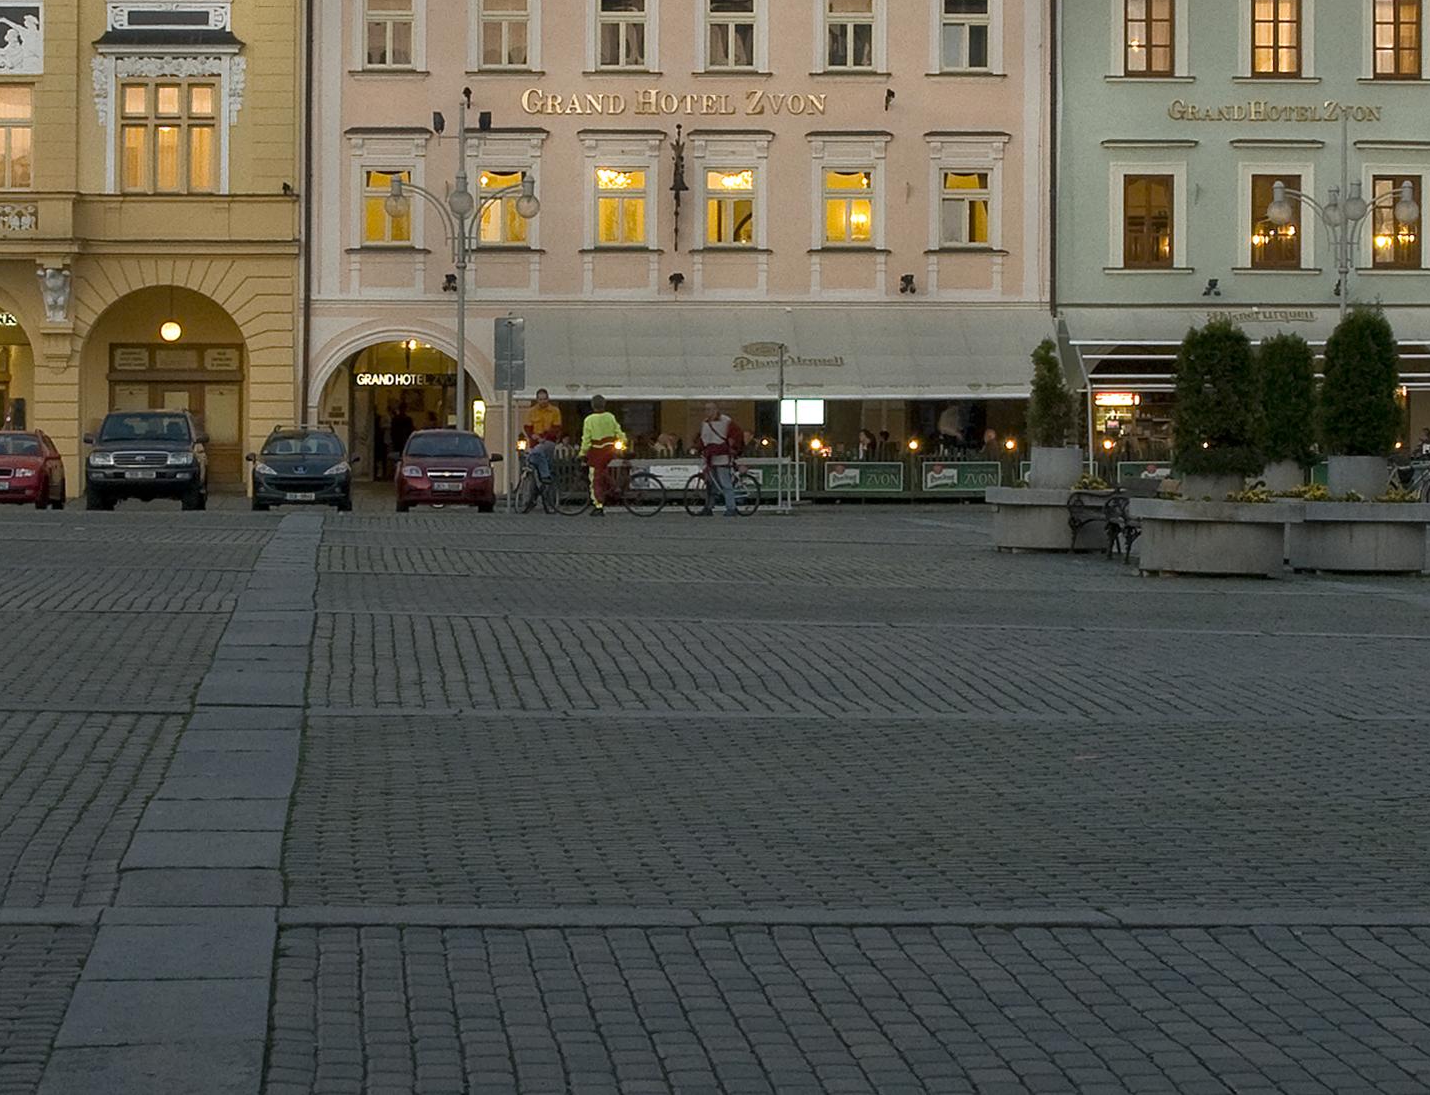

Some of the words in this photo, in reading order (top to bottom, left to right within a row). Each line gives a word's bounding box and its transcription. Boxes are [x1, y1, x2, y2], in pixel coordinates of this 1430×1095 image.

[521, 88, 626, 116] GRAND
[634, 88, 736, 116] HOTEL
[744, 88, 828, 116] ZVON
[1167, 99, 1247, 121] GRAND
[1248, 100, 1318, 121] HOTEL
[1322, 100, 1383, 121] ZVON
[356, 373, 395, 386] GRAND
[395, 373, 429, 386] HOTEL
[866, 474, 899, 486] ZVON
[964, 473, 997, 486] ZVON
